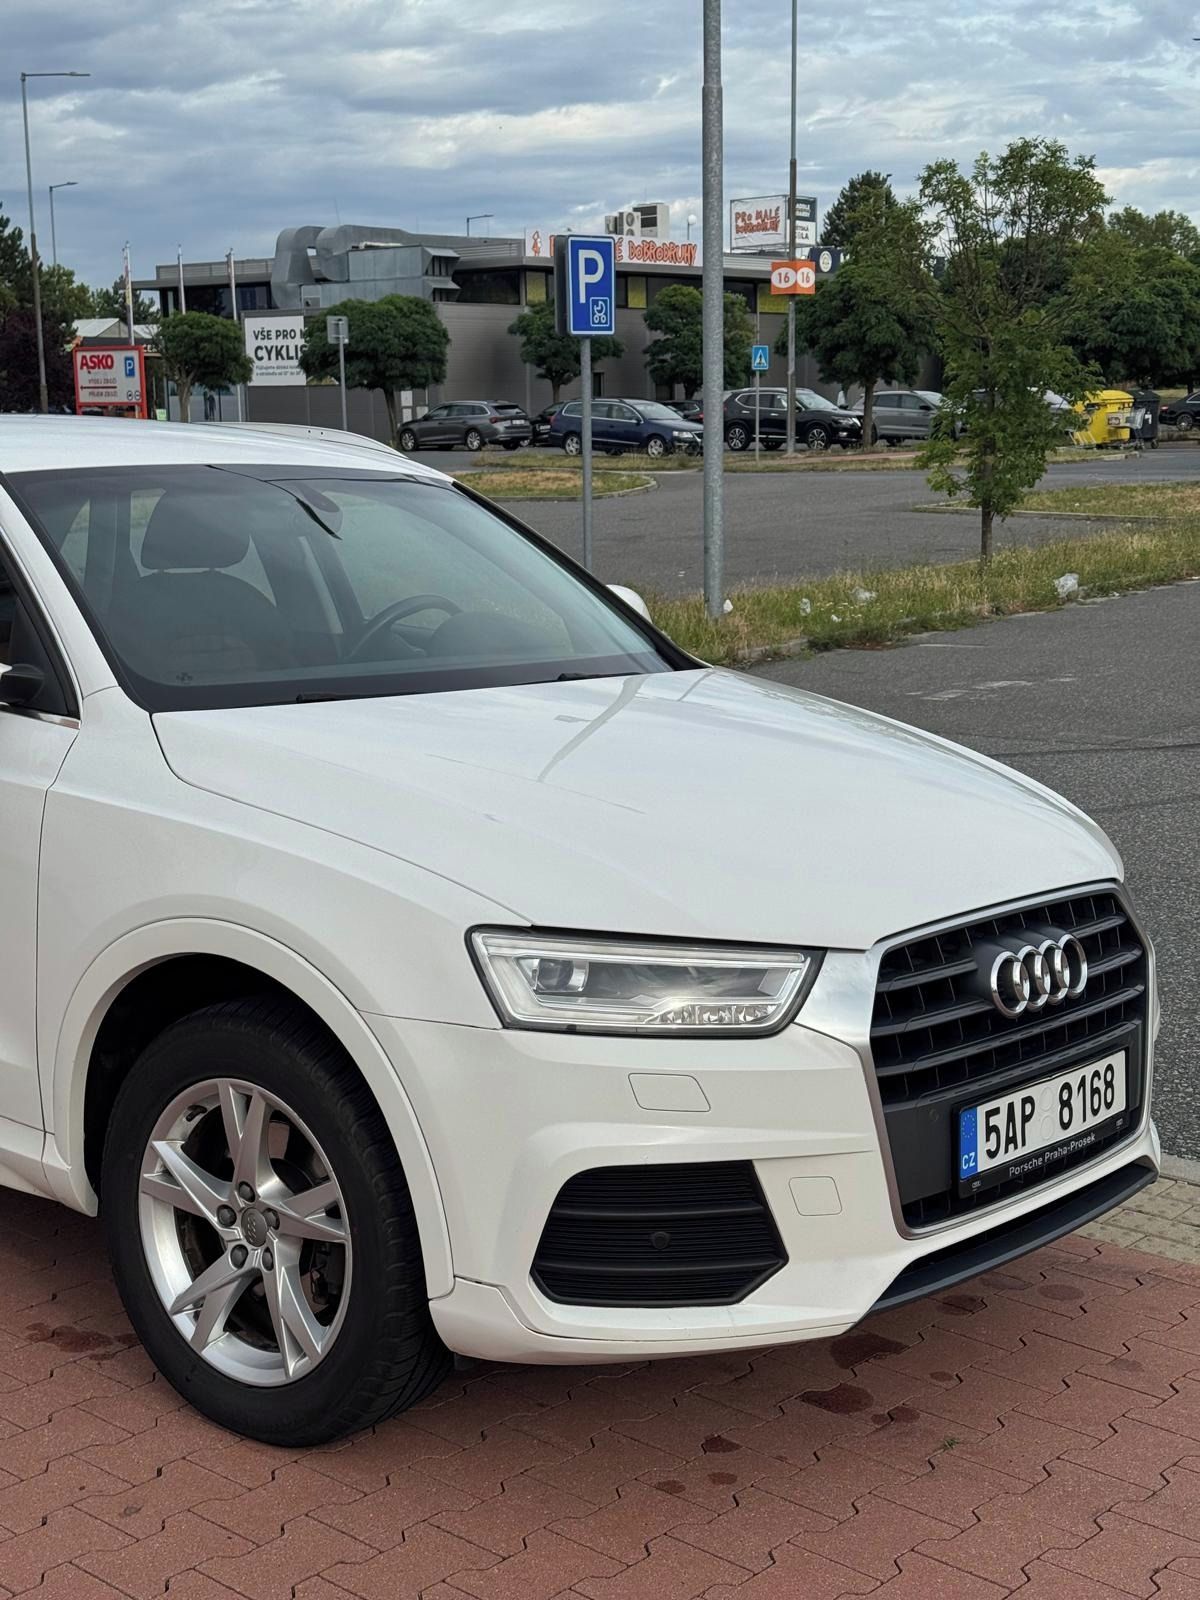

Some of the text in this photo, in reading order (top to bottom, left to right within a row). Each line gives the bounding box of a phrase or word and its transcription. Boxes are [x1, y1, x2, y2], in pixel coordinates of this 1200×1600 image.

[755, 206, 780, 221] MALÉ
[628, 239, 697, 266] DOBRODRUHY
[578, 249, 605, 304] P
[777, 271, 790, 284] 16
[801, 271, 811, 284] 16
[253, 327, 273, 340] VŠE
[275, 328, 297, 340] PRO
[80, 354, 114, 370] ASKO
[126, 360, 134, 374] P
[985, 1063, 1115, 1160] 5AP 8168
[962, 1151, 976, 1170] CZ
[1009, 1132, 1096, 1177] Porsche Praha-Prosek
